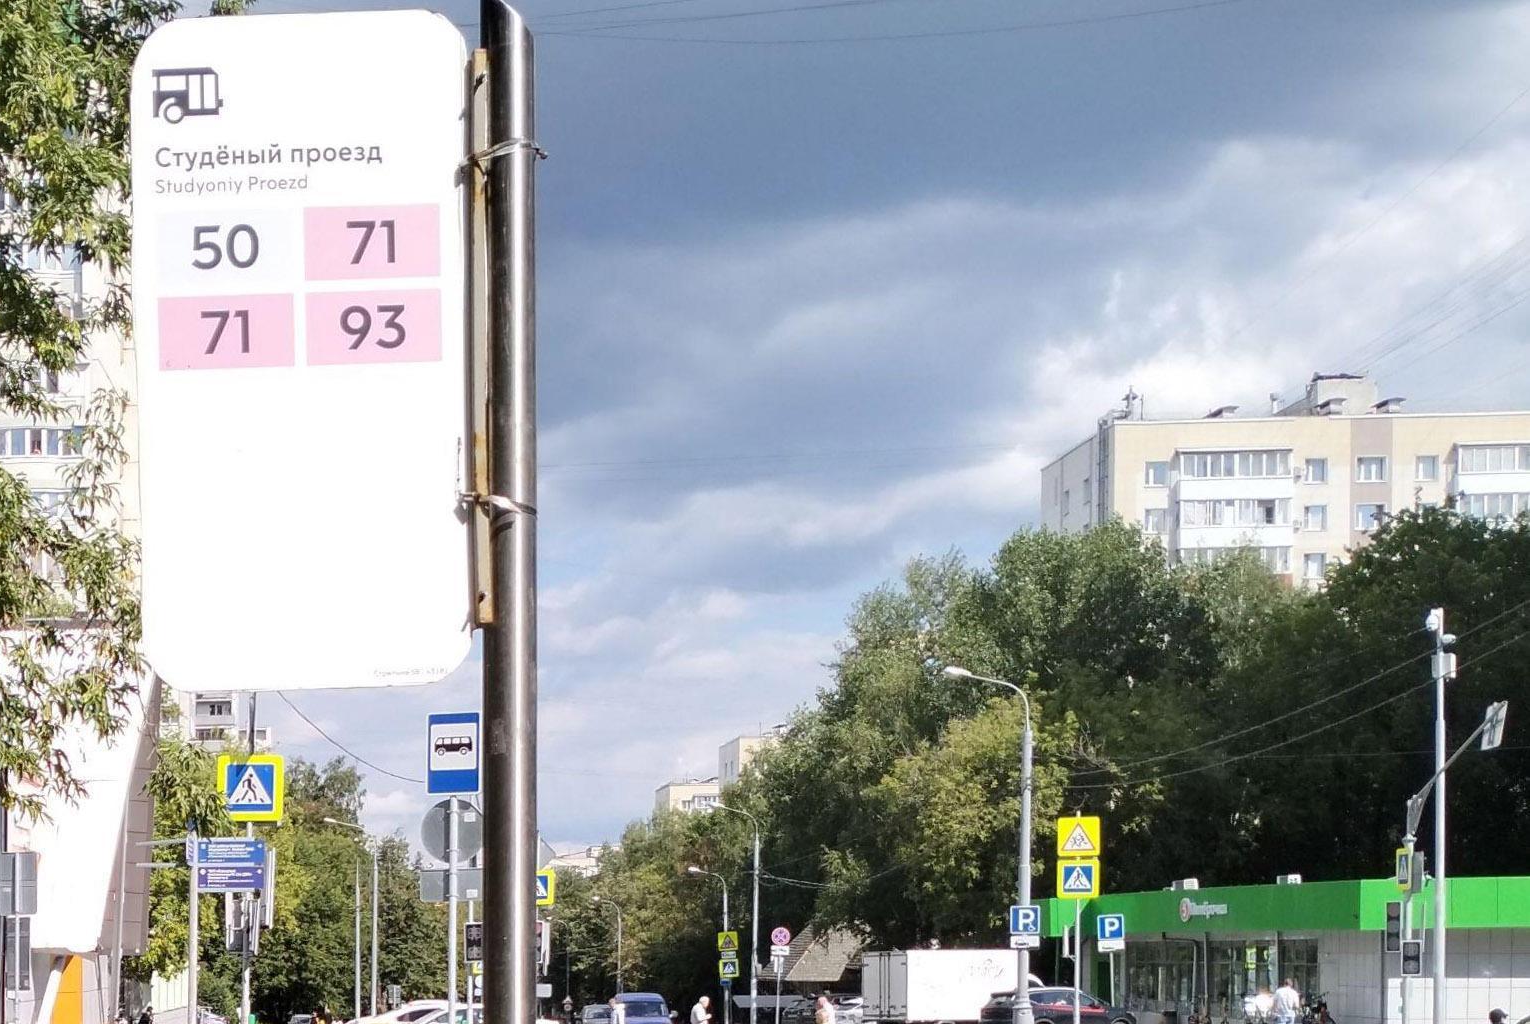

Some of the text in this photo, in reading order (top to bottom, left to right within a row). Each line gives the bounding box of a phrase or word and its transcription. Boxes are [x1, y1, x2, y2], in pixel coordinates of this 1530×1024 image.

[155, 142, 383, 171] Студёный проезд
[155, 174, 308, 196] Studyoniy Proezd
[192, 219, 396, 270] 50 71
[200, 304, 406, 355] 71 93
